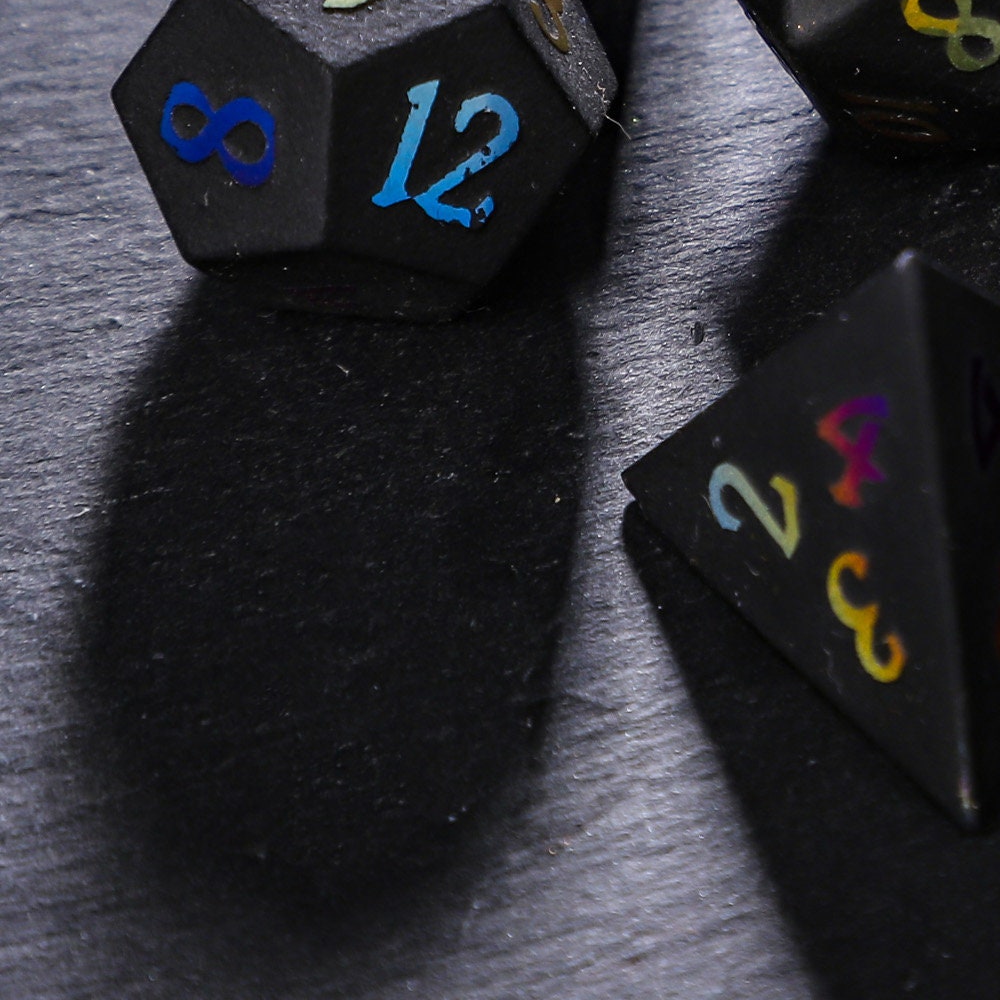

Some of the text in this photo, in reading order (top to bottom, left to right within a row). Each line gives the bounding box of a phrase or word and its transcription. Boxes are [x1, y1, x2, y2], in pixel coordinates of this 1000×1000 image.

[160, 81, 275, 187] 8
[370, 79, 521, 229] 12
[816, 394, 890, 507] 4
[707, 462, 801, 560] 2
[826, 550, 908, 684] 3
